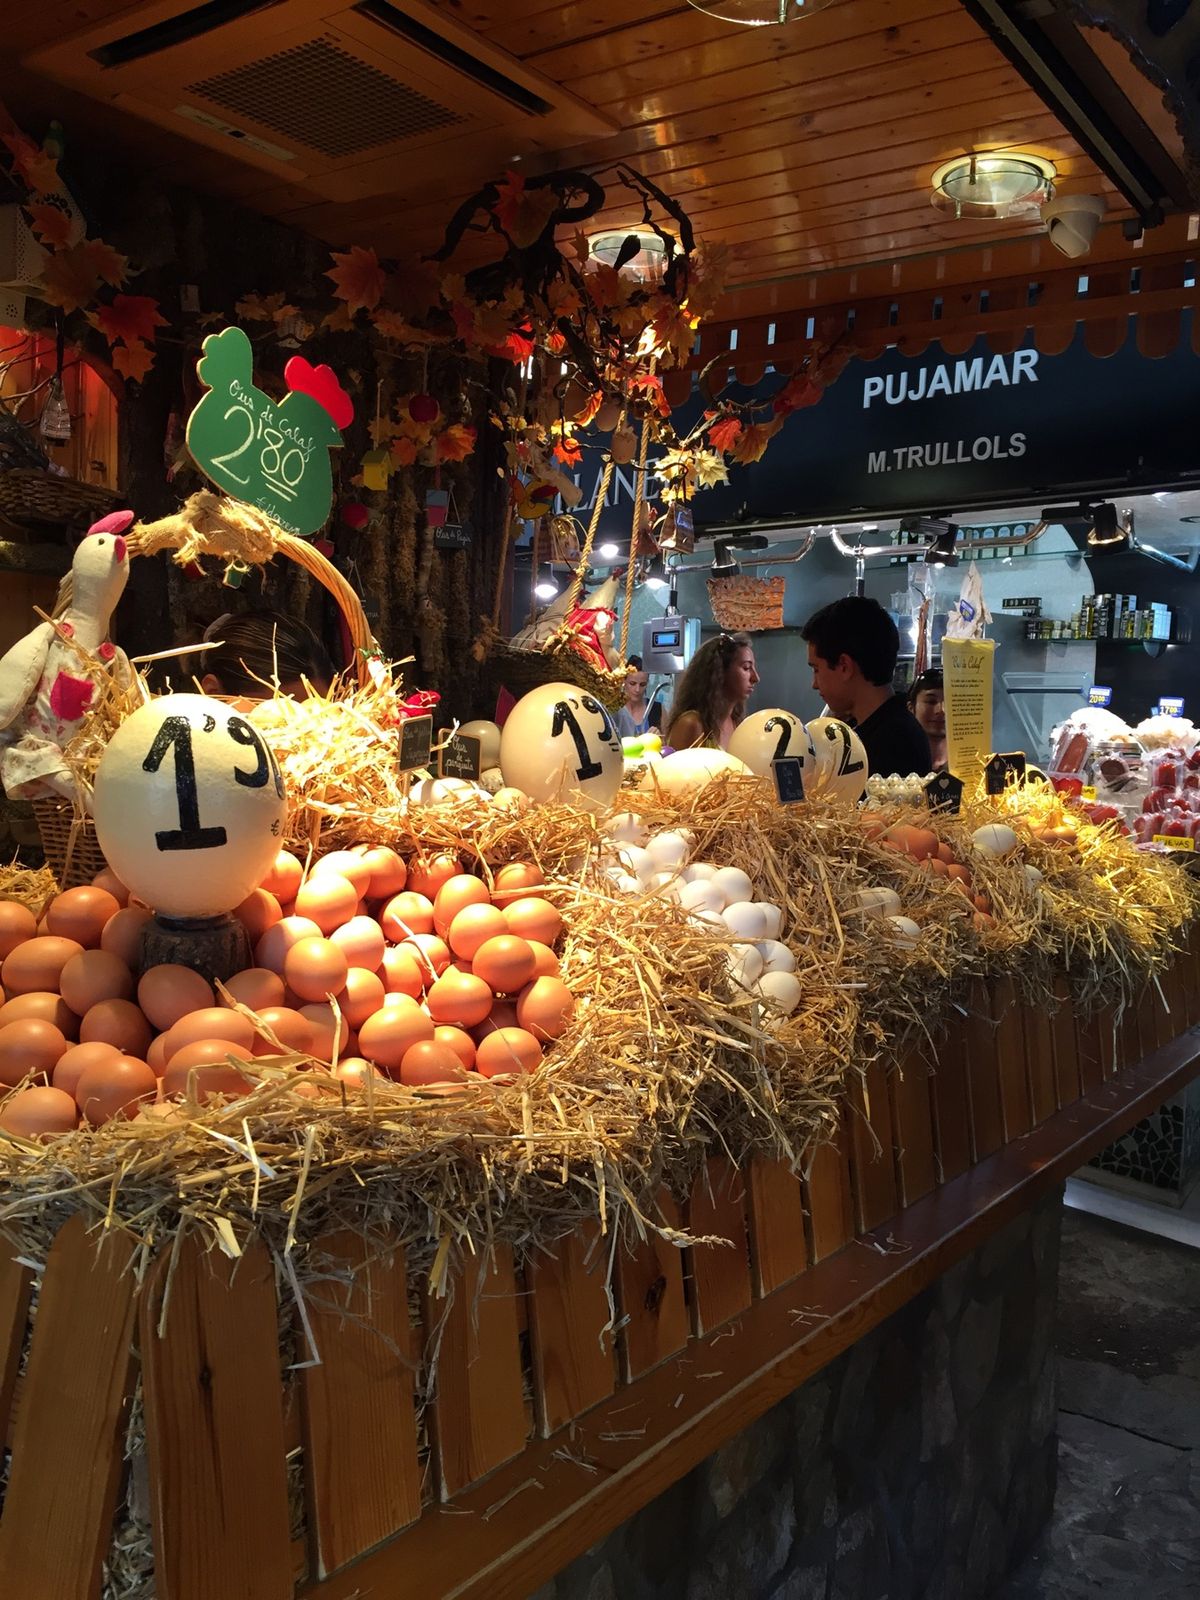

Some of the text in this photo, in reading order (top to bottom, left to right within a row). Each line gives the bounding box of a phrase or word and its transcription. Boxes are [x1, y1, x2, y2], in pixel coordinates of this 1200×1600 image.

[229, 378, 255, 411] Ous
[260, 404, 274, 426] de
[862, 348, 1039, 409] PUJAMAR
[866, 432, 1027, 474] M.TRULLOLS
